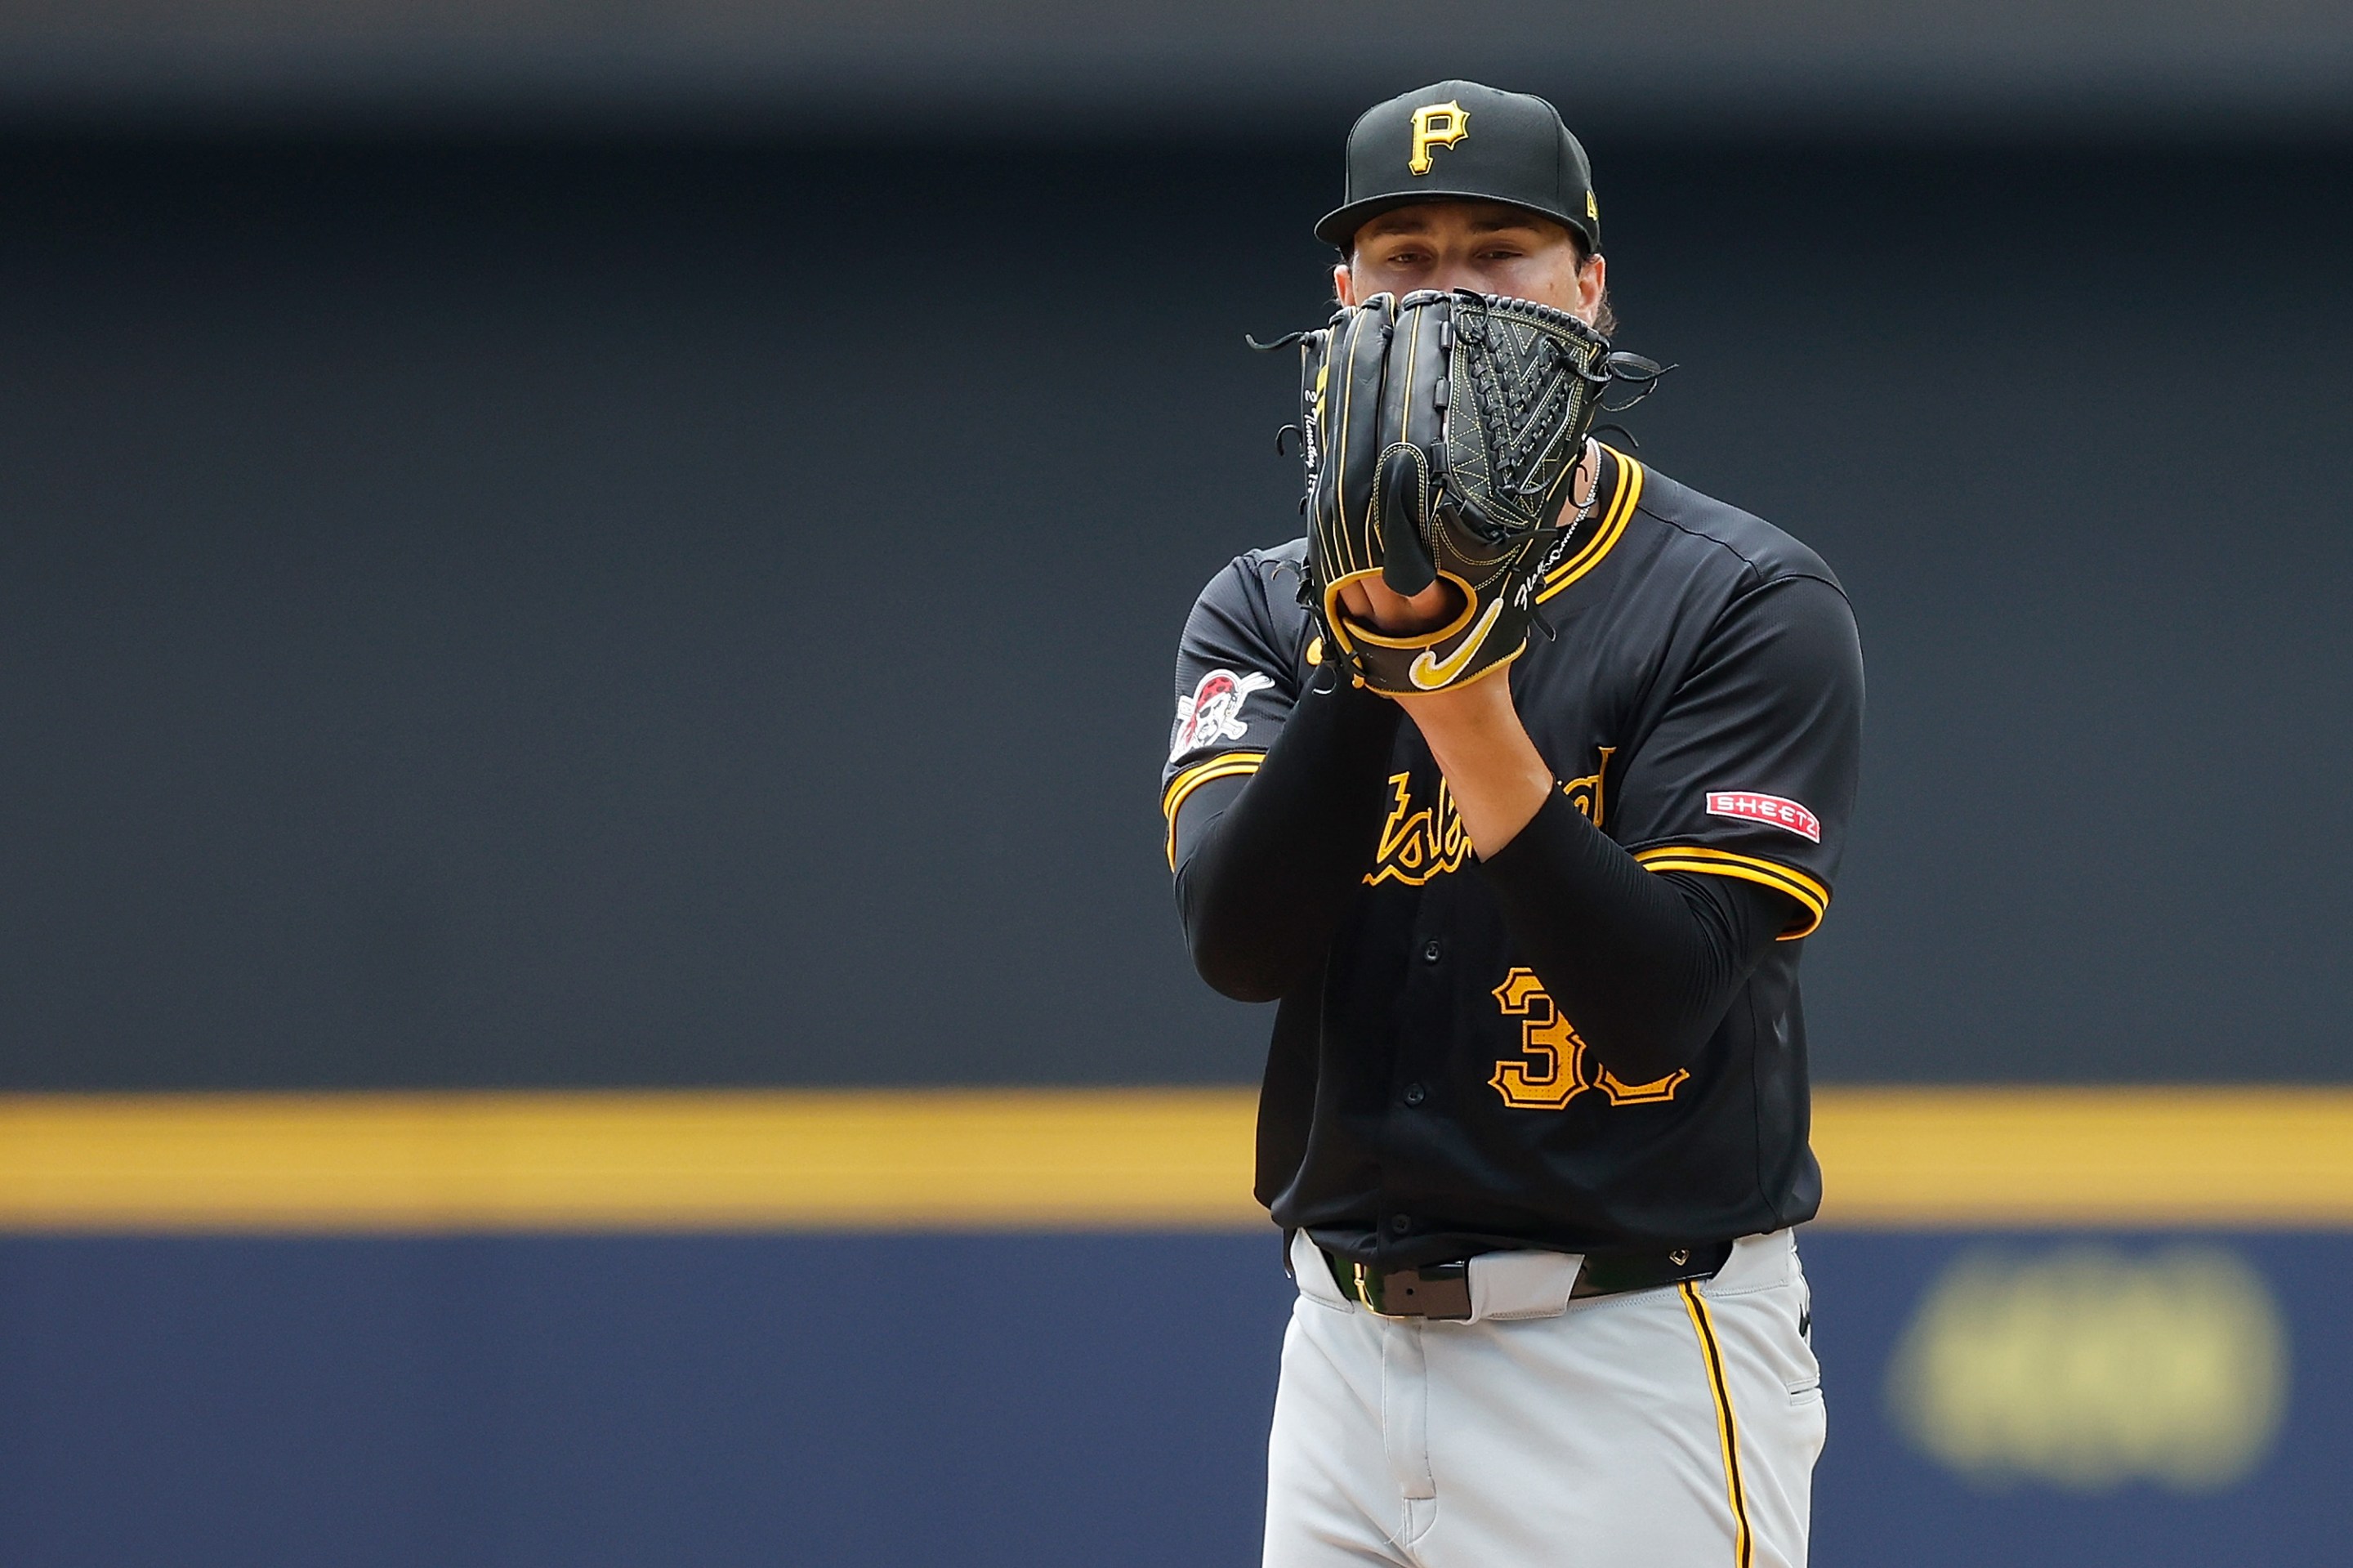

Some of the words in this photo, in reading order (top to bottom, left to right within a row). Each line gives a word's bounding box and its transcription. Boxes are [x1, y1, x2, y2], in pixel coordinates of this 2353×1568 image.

[1408, 99, 1471, 176] P
[1304, 389, 1318, 403] 2
[1304, 408, 1318, 469] Timothy
[1717, 797, 1817, 835] SHEETZ
